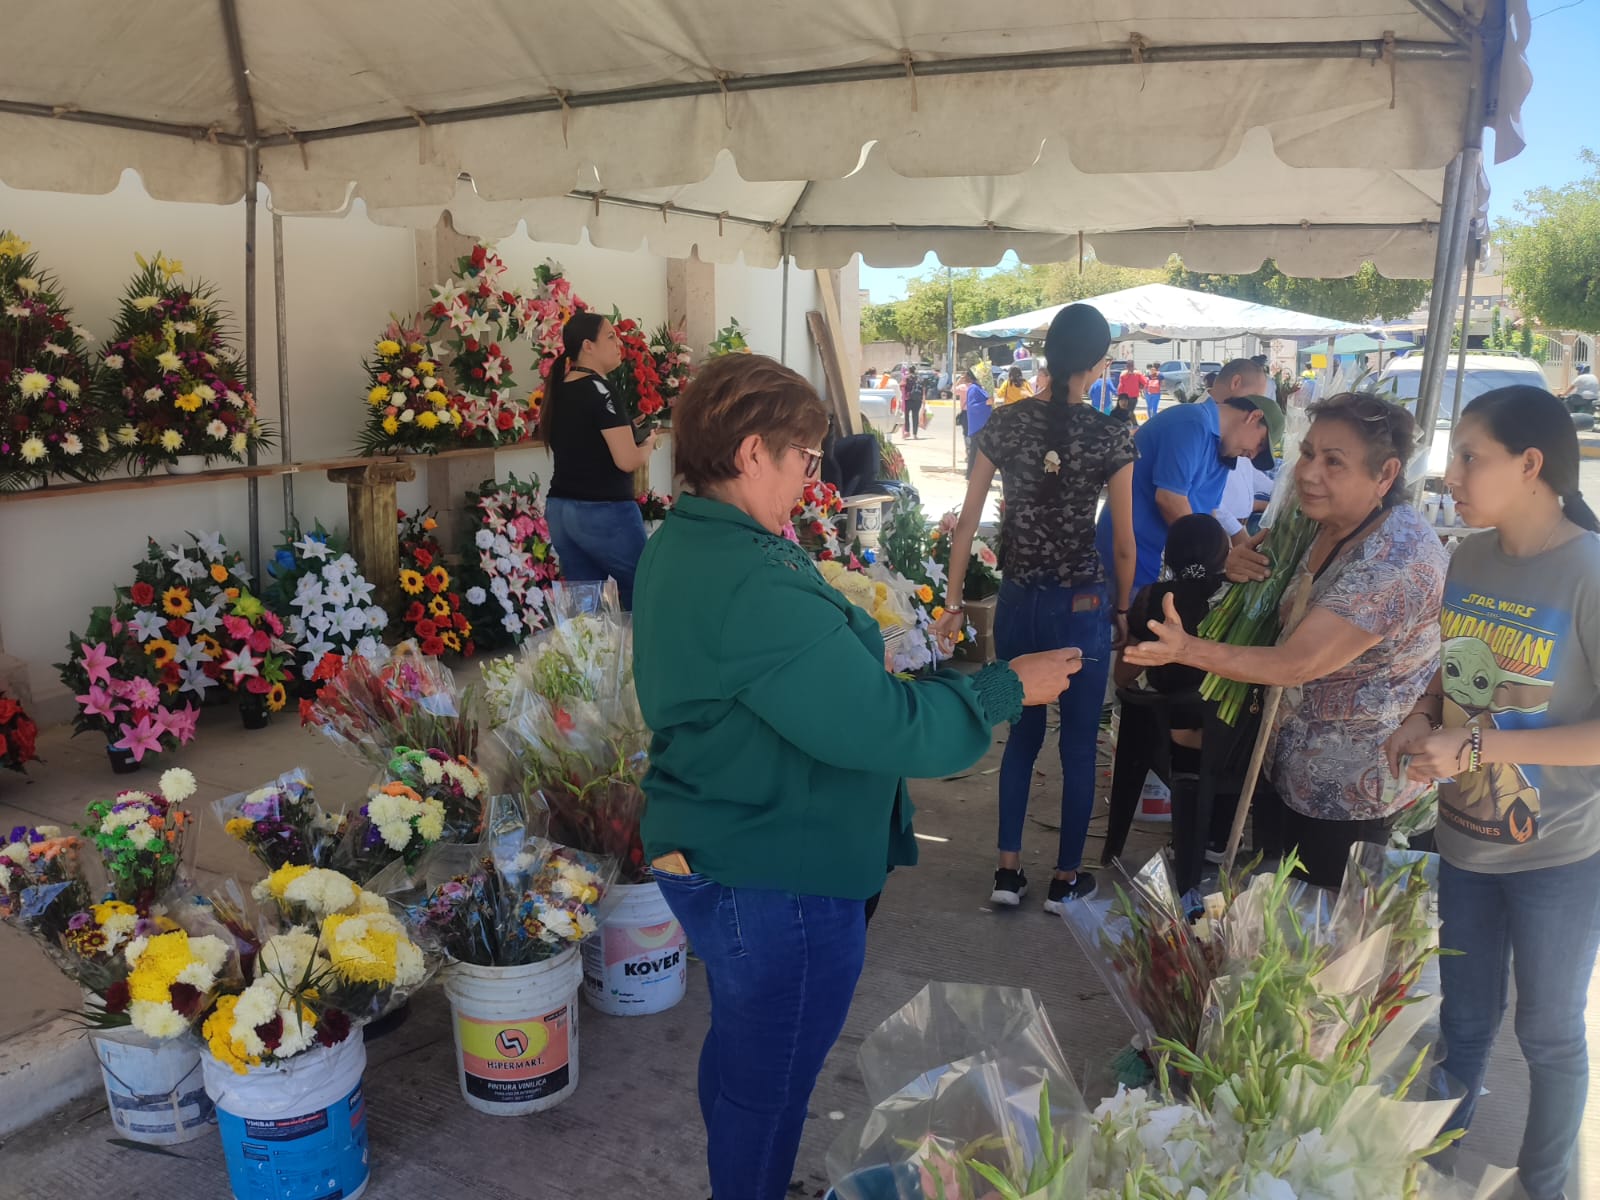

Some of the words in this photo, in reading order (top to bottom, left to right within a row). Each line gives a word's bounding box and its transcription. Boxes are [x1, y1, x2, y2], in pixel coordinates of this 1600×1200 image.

[1462, 593, 1496, 609] STAR
[1498, 600, 1537, 618] WARS
[624, 951, 680, 976] KOVER
